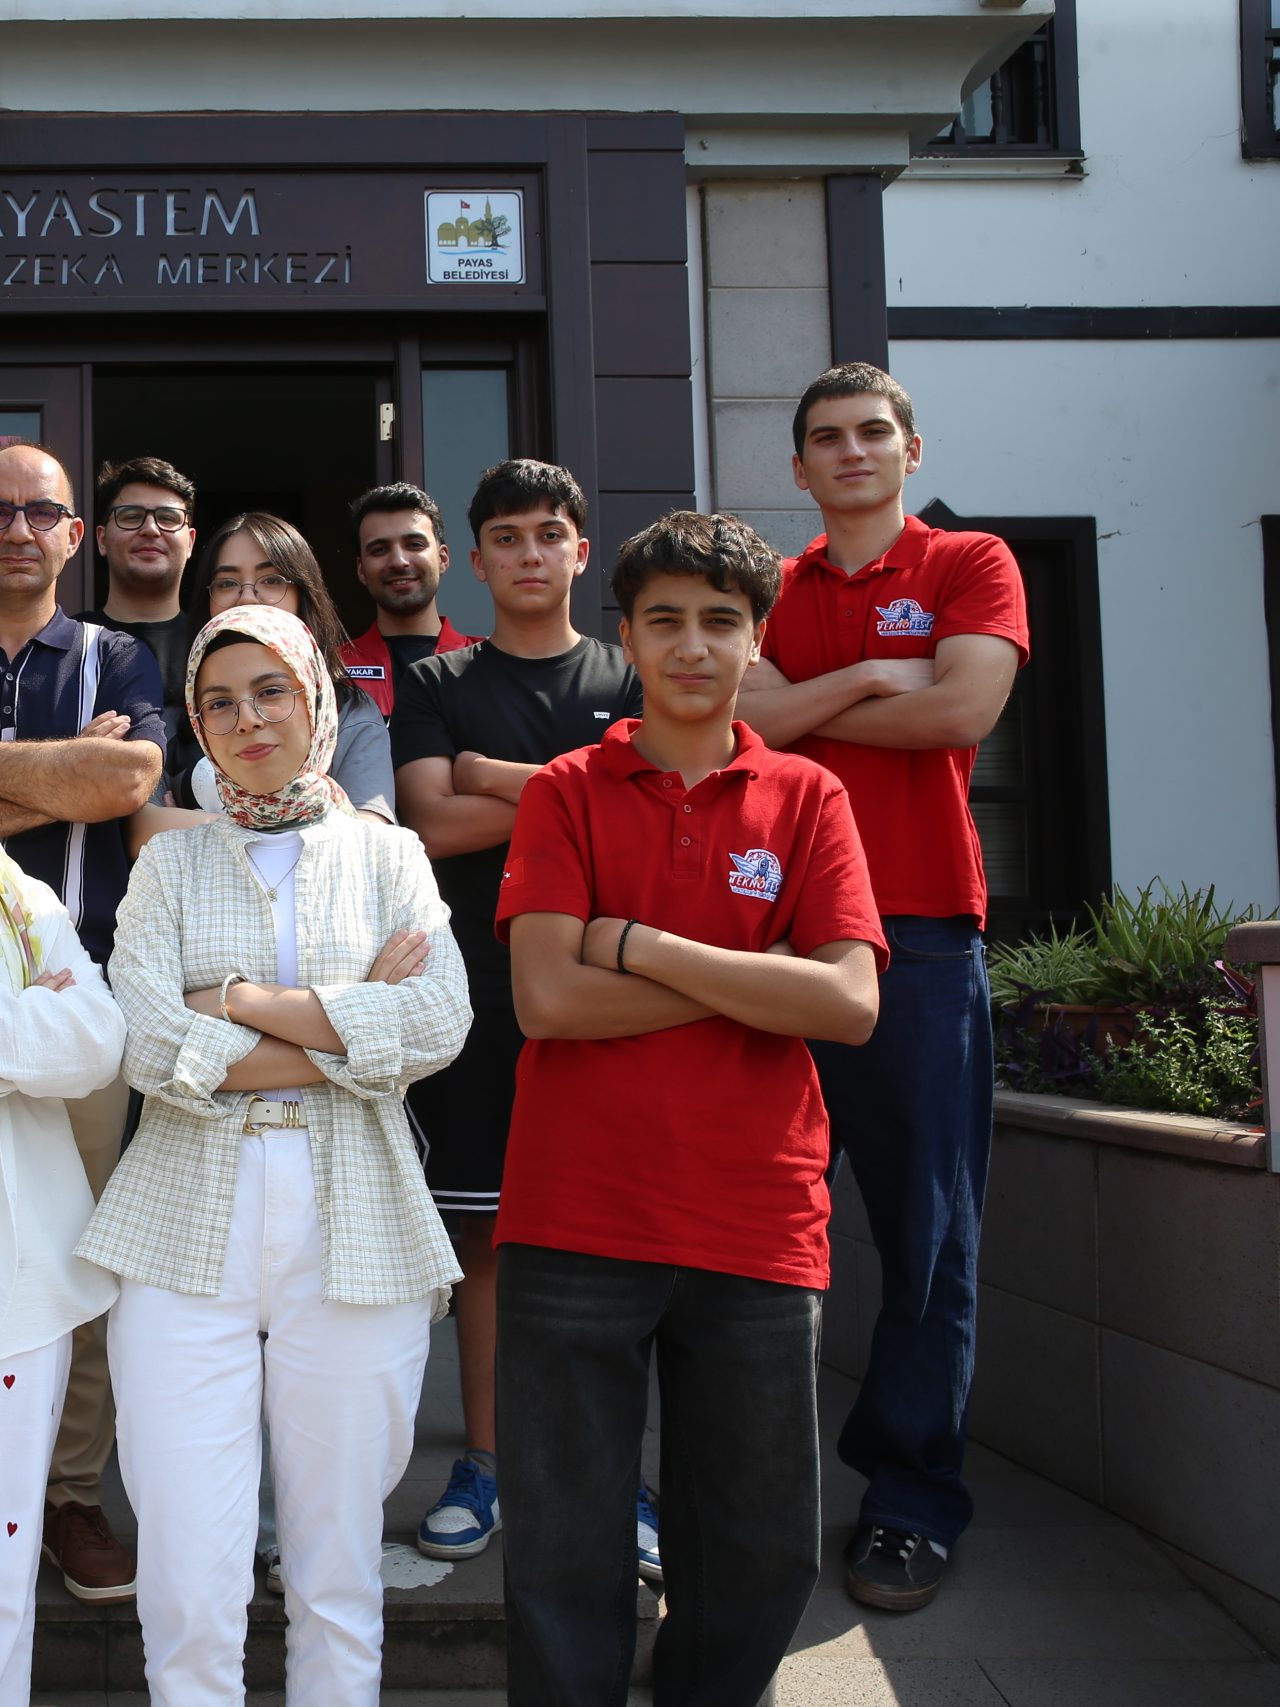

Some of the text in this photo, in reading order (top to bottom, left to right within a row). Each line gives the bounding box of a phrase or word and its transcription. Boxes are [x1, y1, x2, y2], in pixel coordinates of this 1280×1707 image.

[3, 254, 125, 286] ZEKA
[157, 245, 352, 285] MERKEZİ
[457, 258, 493, 268] PAYAS
[443, 269, 509, 280] BELEDİYESİ
[878, 619, 930, 631] TEKNOFEST
[729, 875, 780, 893] TEKNOFES
